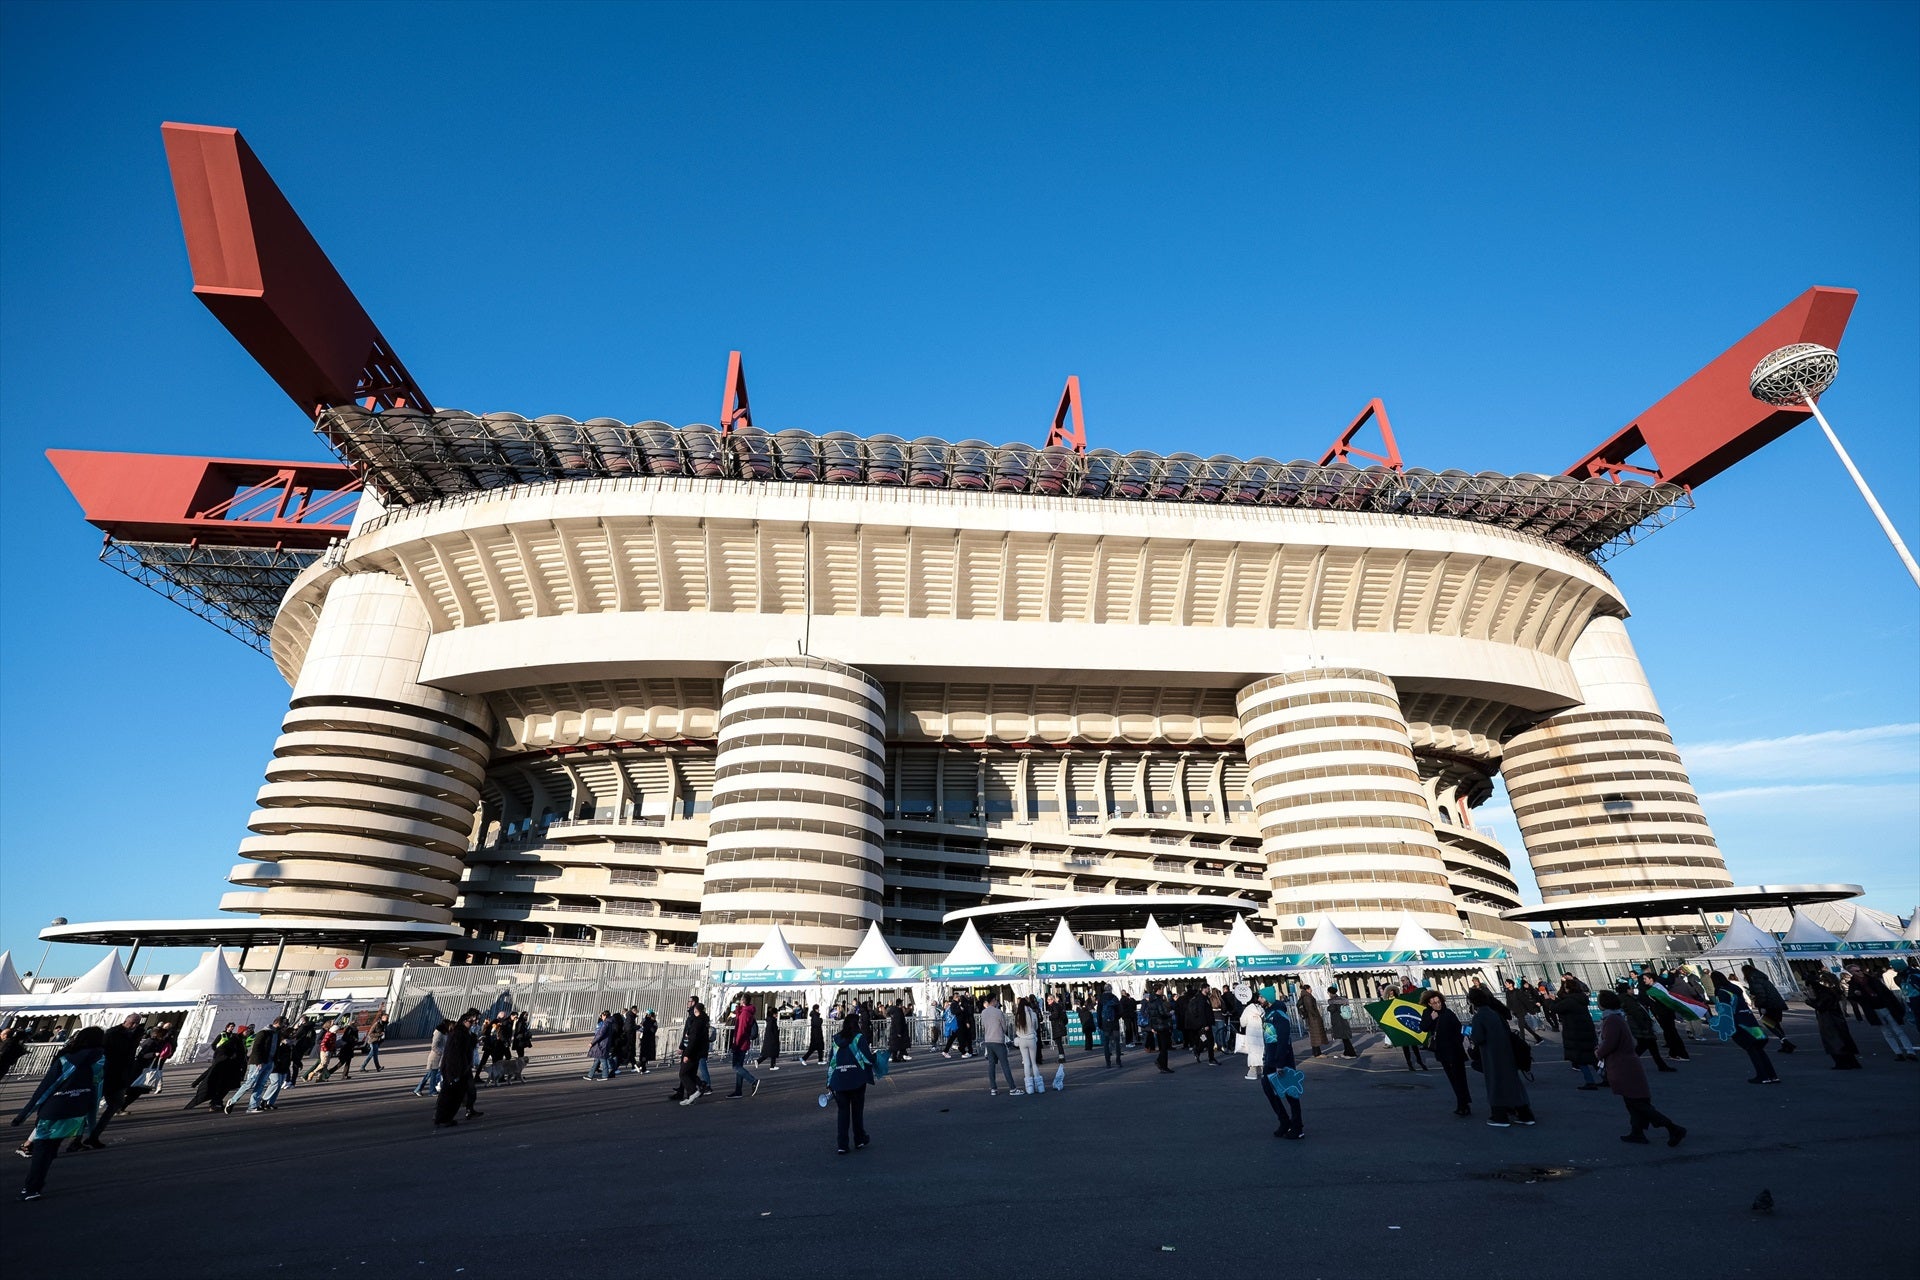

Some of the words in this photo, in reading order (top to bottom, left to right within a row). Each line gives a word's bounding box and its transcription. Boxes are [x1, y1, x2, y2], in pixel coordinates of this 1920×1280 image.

[1090, 963, 1096, 971] A
[1187, 959, 1193, 967] A
[877, 969, 883, 977] A
[983, 966, 990, 974] A
[776, 971, 782, 979] A
